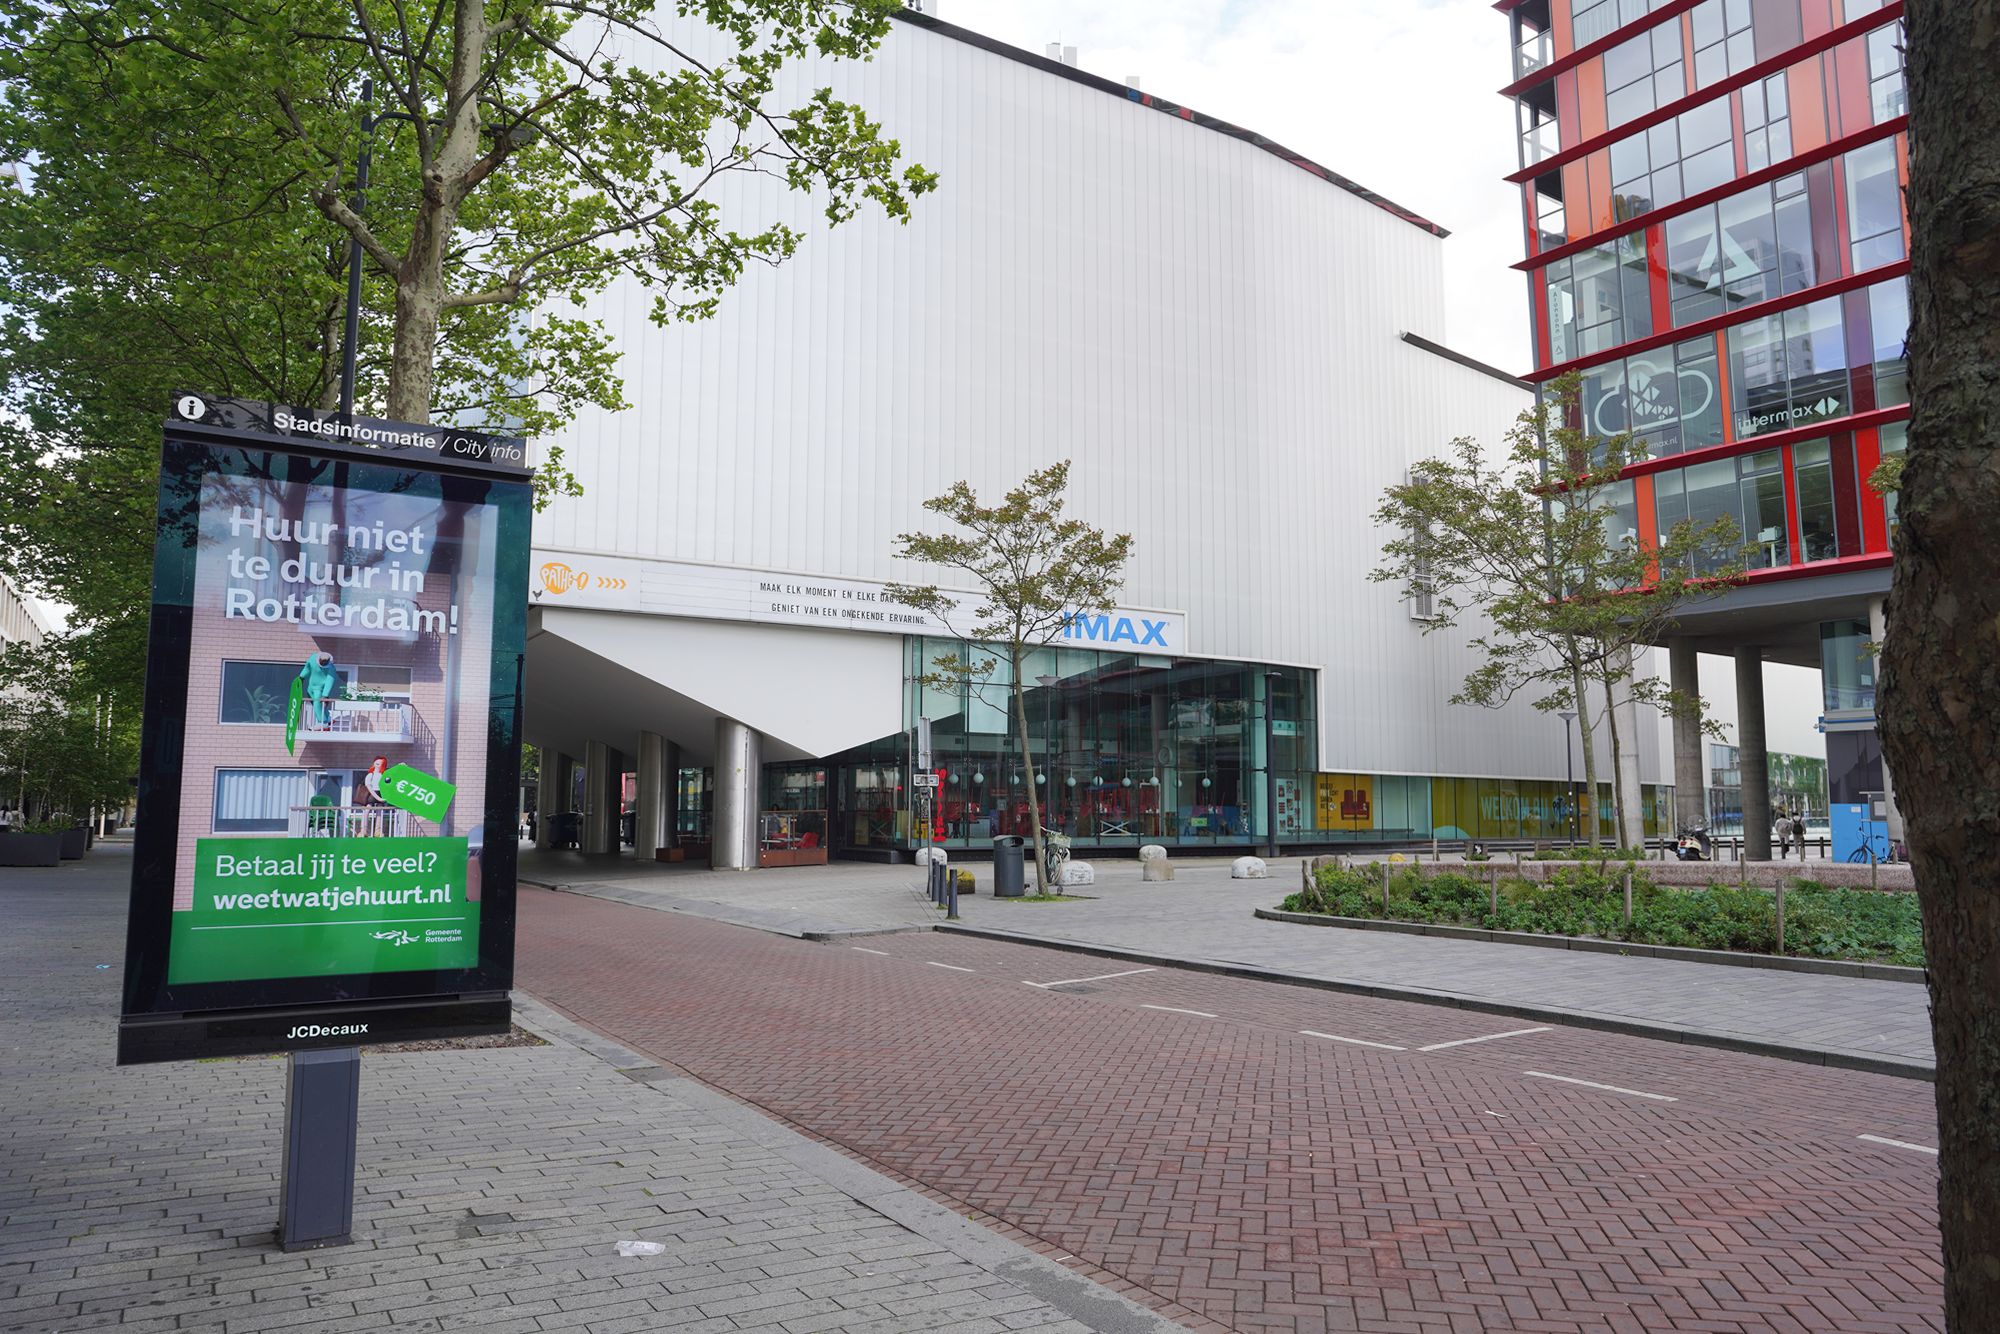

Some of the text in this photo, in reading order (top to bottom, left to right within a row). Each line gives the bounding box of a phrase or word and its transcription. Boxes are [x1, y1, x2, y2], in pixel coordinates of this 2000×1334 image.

[1738, 404, 1813, 432] intermax
[273, 412, 436, 449] Stadsinformatie
[453, 437, 487, 459] City
[491, 442, 521, 461] info
[229, 506, 424, 555] Huur niet
[227, 547, 424, 593] te duur in
[760, 582, 781, 592] MAAK
[787, 585, 801, 594] ELK
[806, 587, 837, 598] MOMENT
[842, 590, 852, 599] EN
[857, 591, 875, 602] ELKE
[225, 588, 458, 635] Rotterdam!
[771, 603, 800, 613] GENIET
[805, 606, 819, 615] VAN
[823, 608, 837, 616] EEN
[889, 614, 927, 625] ERVARING.
[1064, 612, 1168, 647] IMAX
[215, 852, 437, 879] Betaal jij te veel?
[213, 884, 451, 911] weetwatjehuurt.nl
[425, 935, 463, 944] Rotterdam
[286, 1022, 369, 1040] JCDecaux
